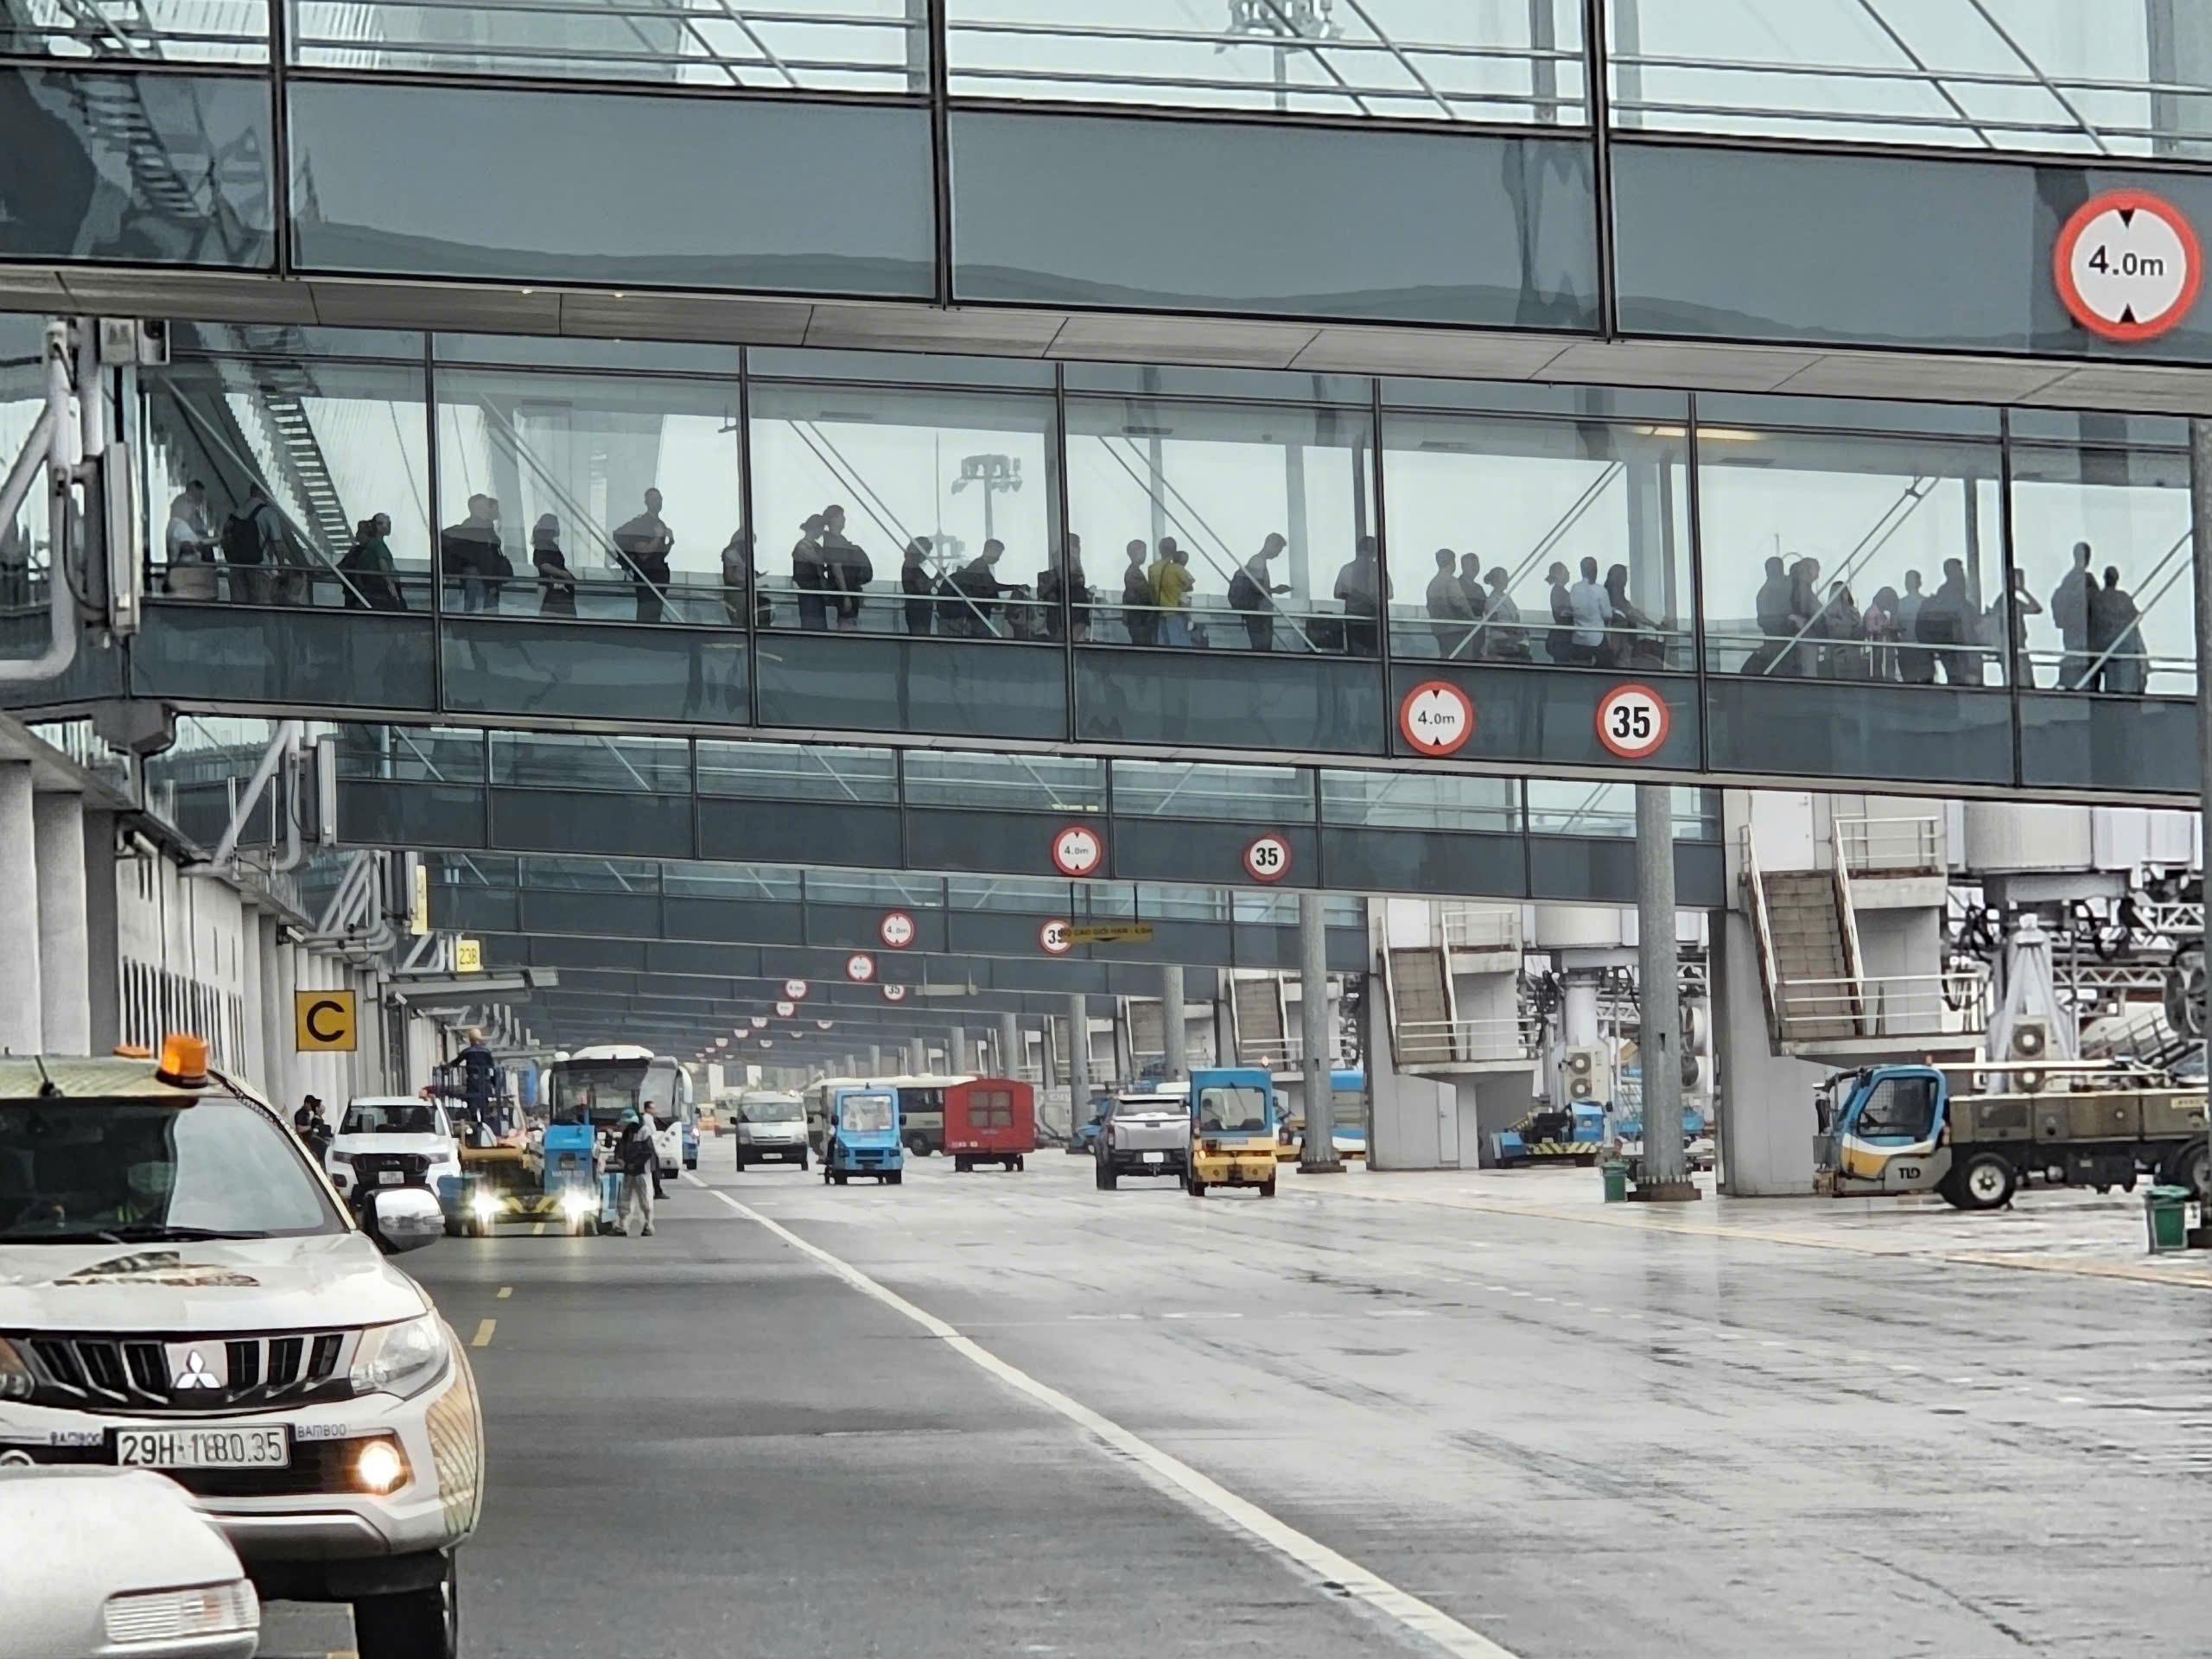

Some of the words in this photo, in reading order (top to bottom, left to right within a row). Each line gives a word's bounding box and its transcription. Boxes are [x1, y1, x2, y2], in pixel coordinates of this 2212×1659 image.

[2088, 244, 2164, 276] 4.0m
[1417, 710, 1456, 726] 4.0m
[1612, 706, 1651, 739] 35
[1064, 845, 1090, 856] 4.0m
[1255, 848, 1279, 867] 35
[459, 947, 478, 965] 23B
[306, 1000, 346, 1043] C
[1898, 1167, 1921, 1179] TLD
[297, 1423, 346, 1439] BAMBOO
